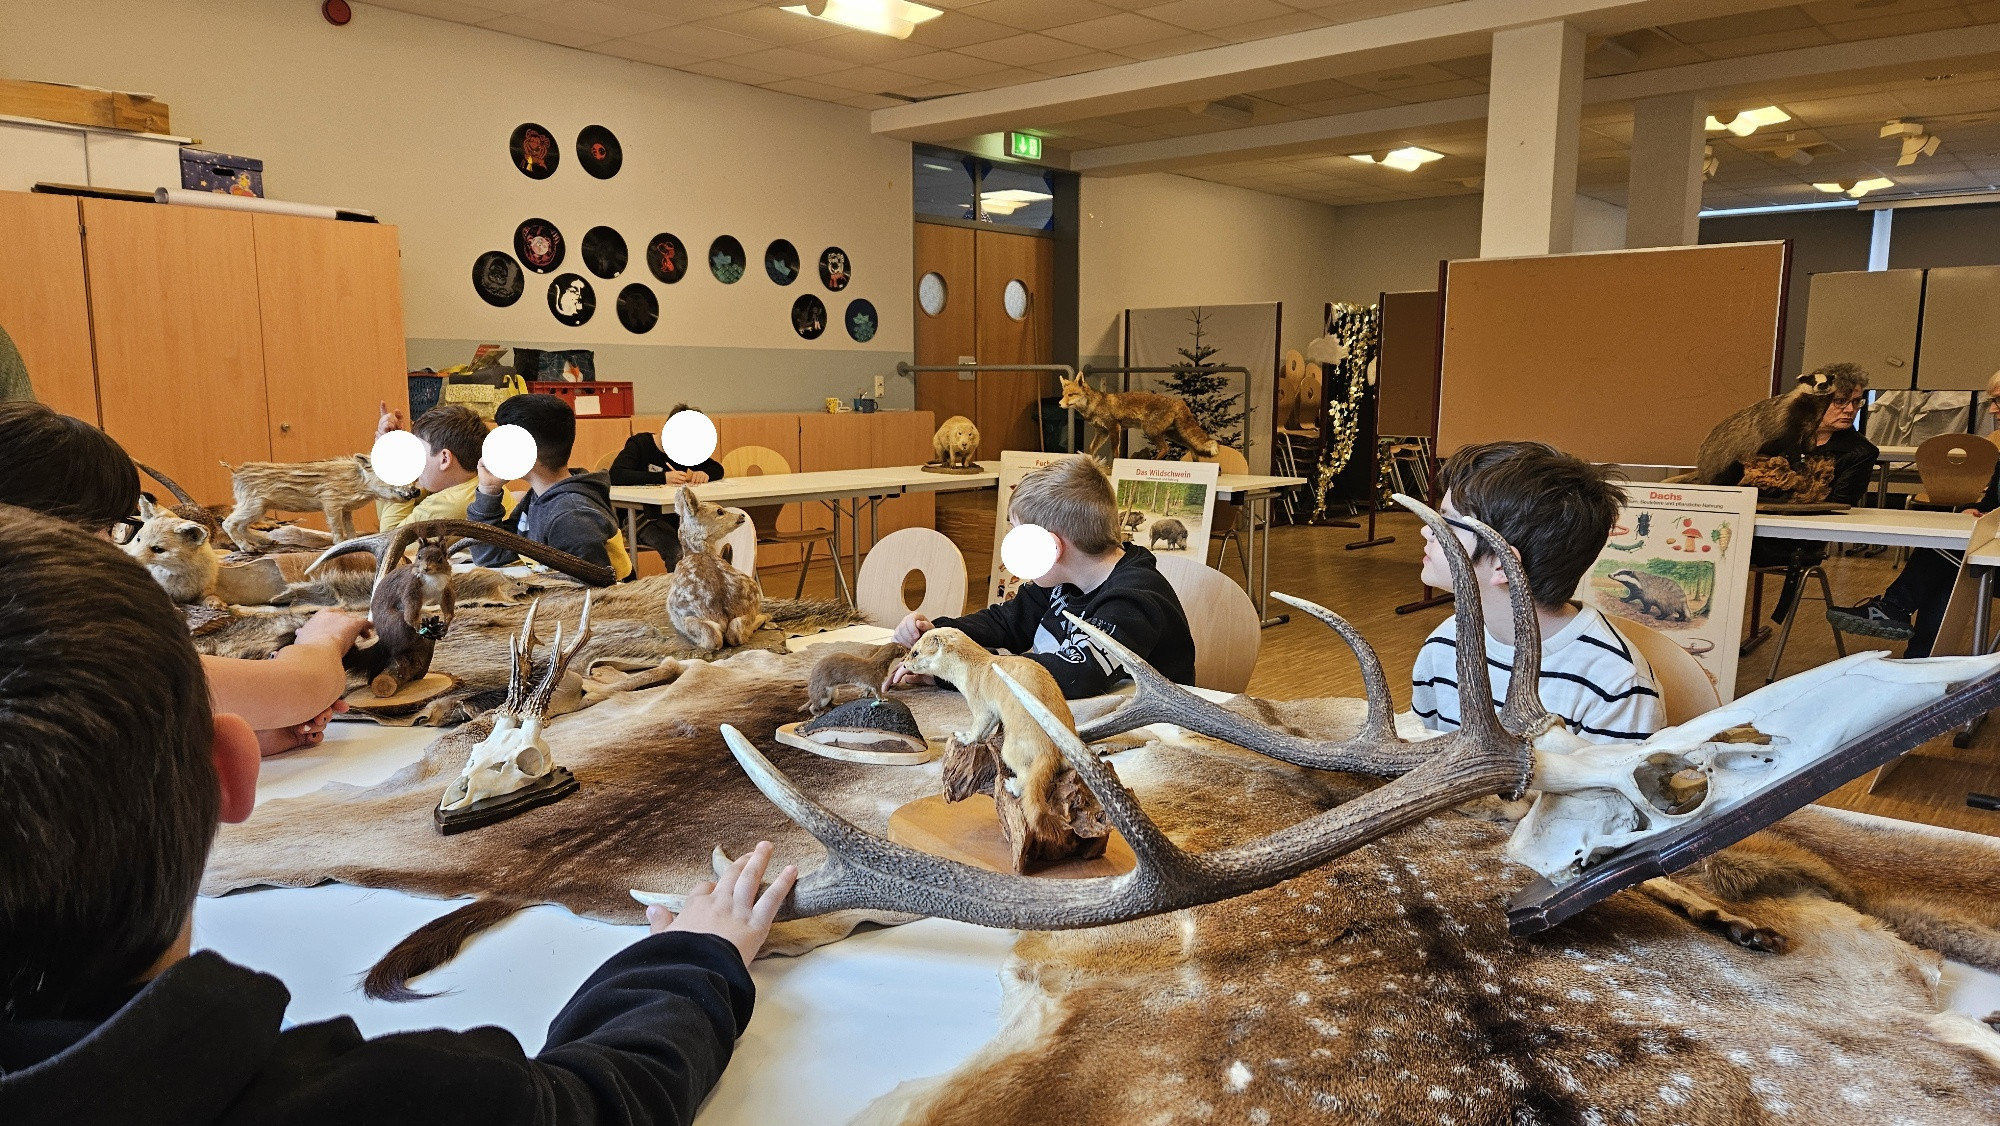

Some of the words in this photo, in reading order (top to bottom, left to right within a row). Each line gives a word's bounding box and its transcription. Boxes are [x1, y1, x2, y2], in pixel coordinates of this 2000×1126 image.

[1035, 459, 1050, 467] Fuch
[1135, 468, 1148, 476] Das
[1149, 469, 1191, 478] Wildschwein
[1649, 491, 1683, 501] Dachs
